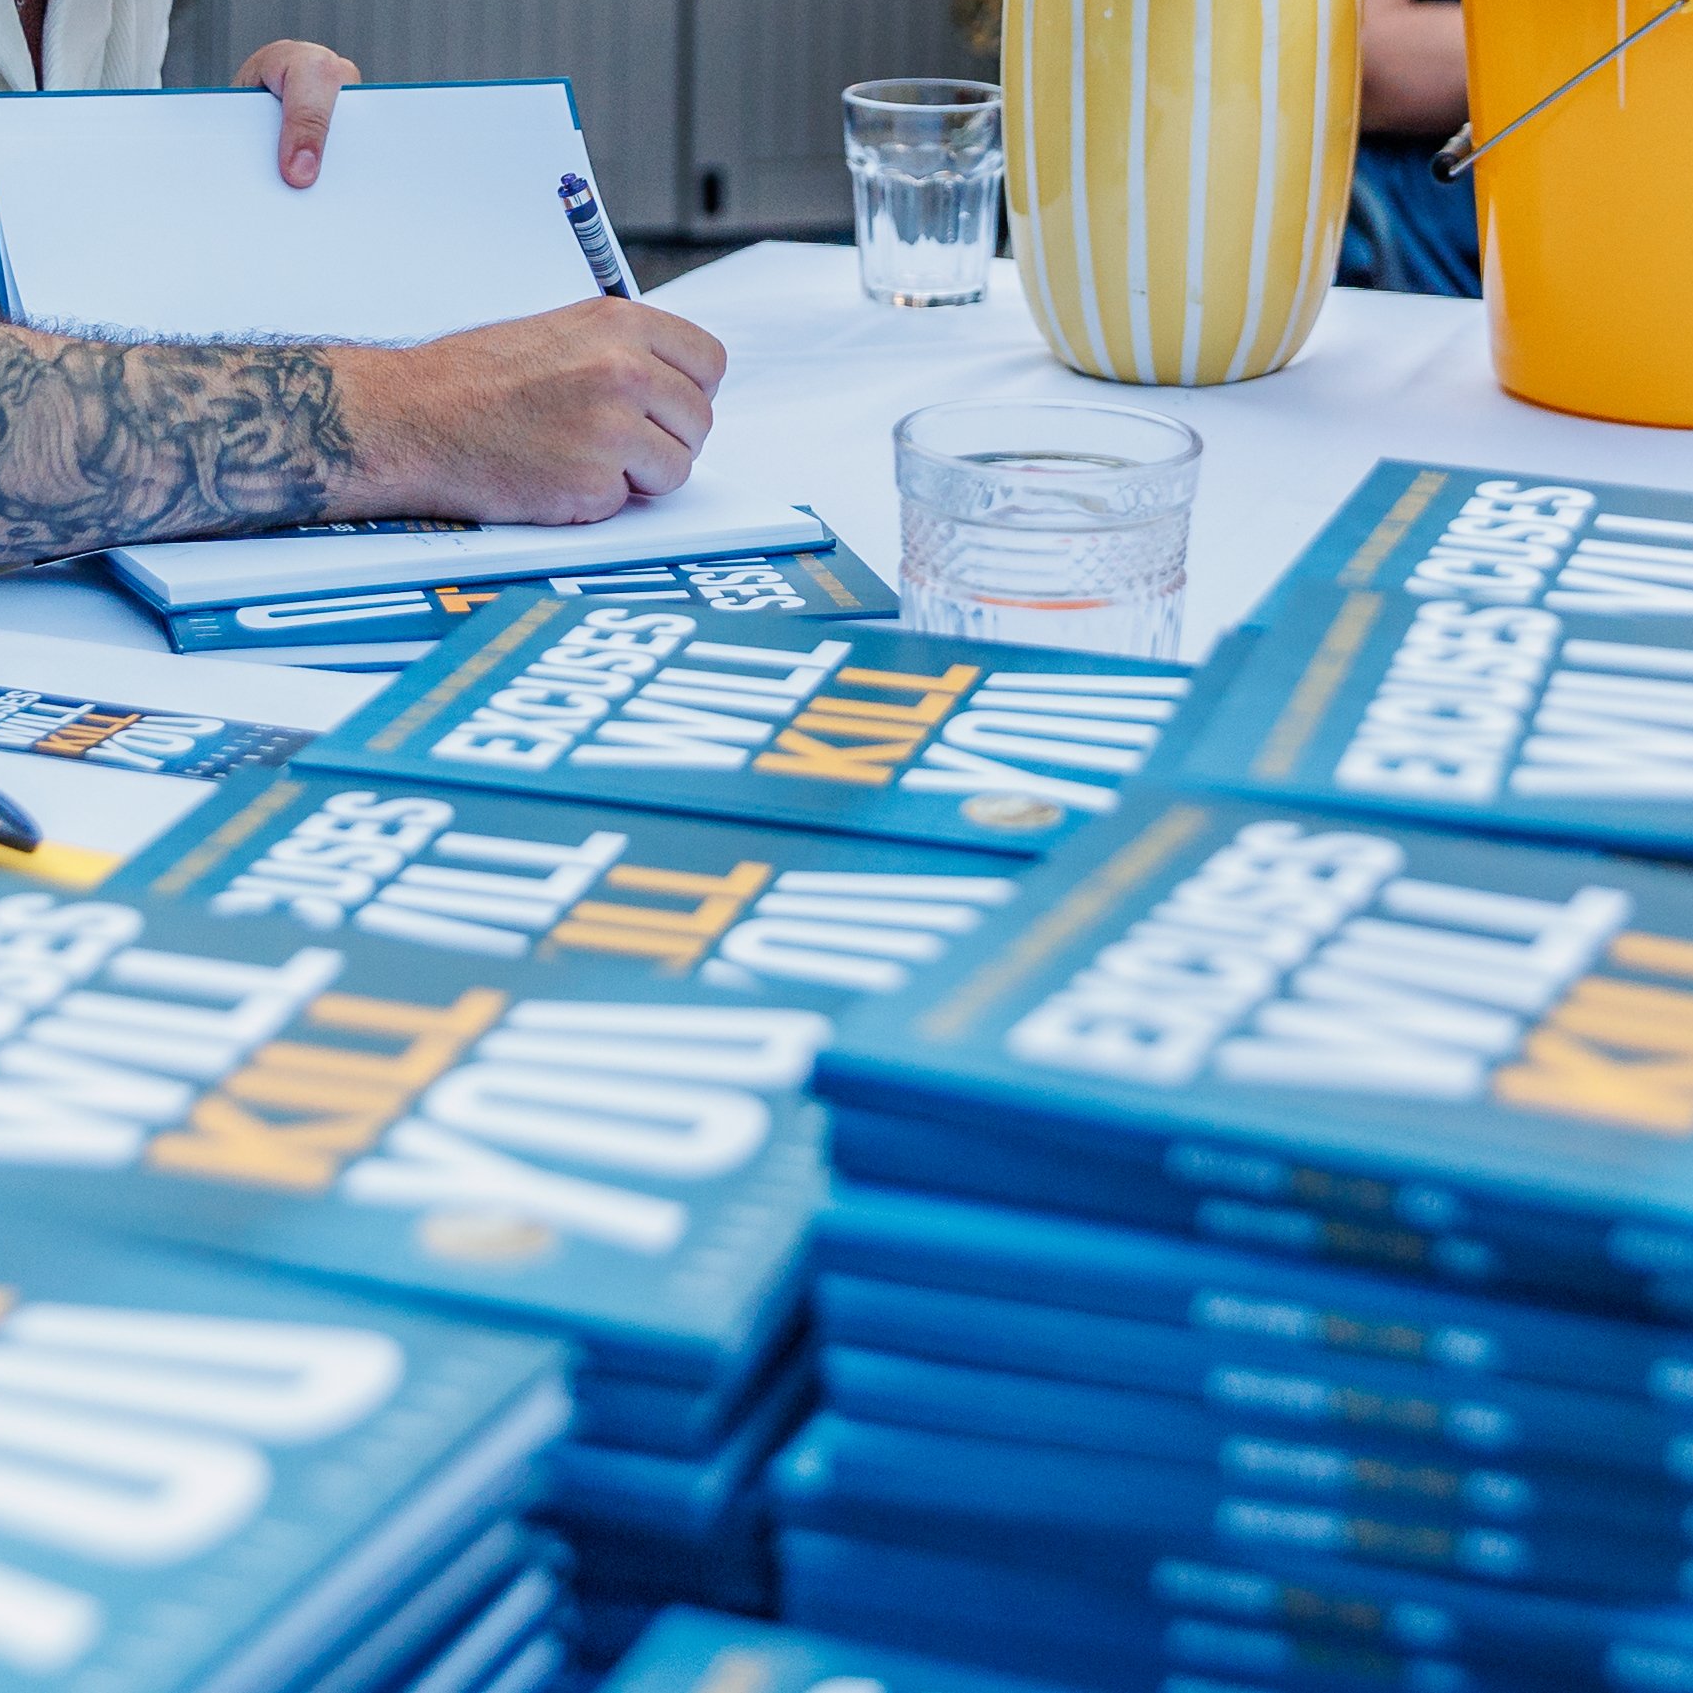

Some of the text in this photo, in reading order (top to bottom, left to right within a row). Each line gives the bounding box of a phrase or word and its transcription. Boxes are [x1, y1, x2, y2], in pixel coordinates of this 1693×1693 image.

[35, 713, 142, 755] KILL
[84, 715, 225, 769] YOU
[428, 607, 697, 770] EXCUSES
[568, 640, 854, 770] WILL
[752, 663, 983, 785] KILL
[1334, 600, 1562, 806] EXCUSES
[536, 860, 773, 976] ILL
[1003, 820, 1407, 1088] EXCUSES
[1208, 886, 1633, 1101] WILL
[144, 987, 510, 1193] KILL
[337, 1000, 837, 1256] YOU
